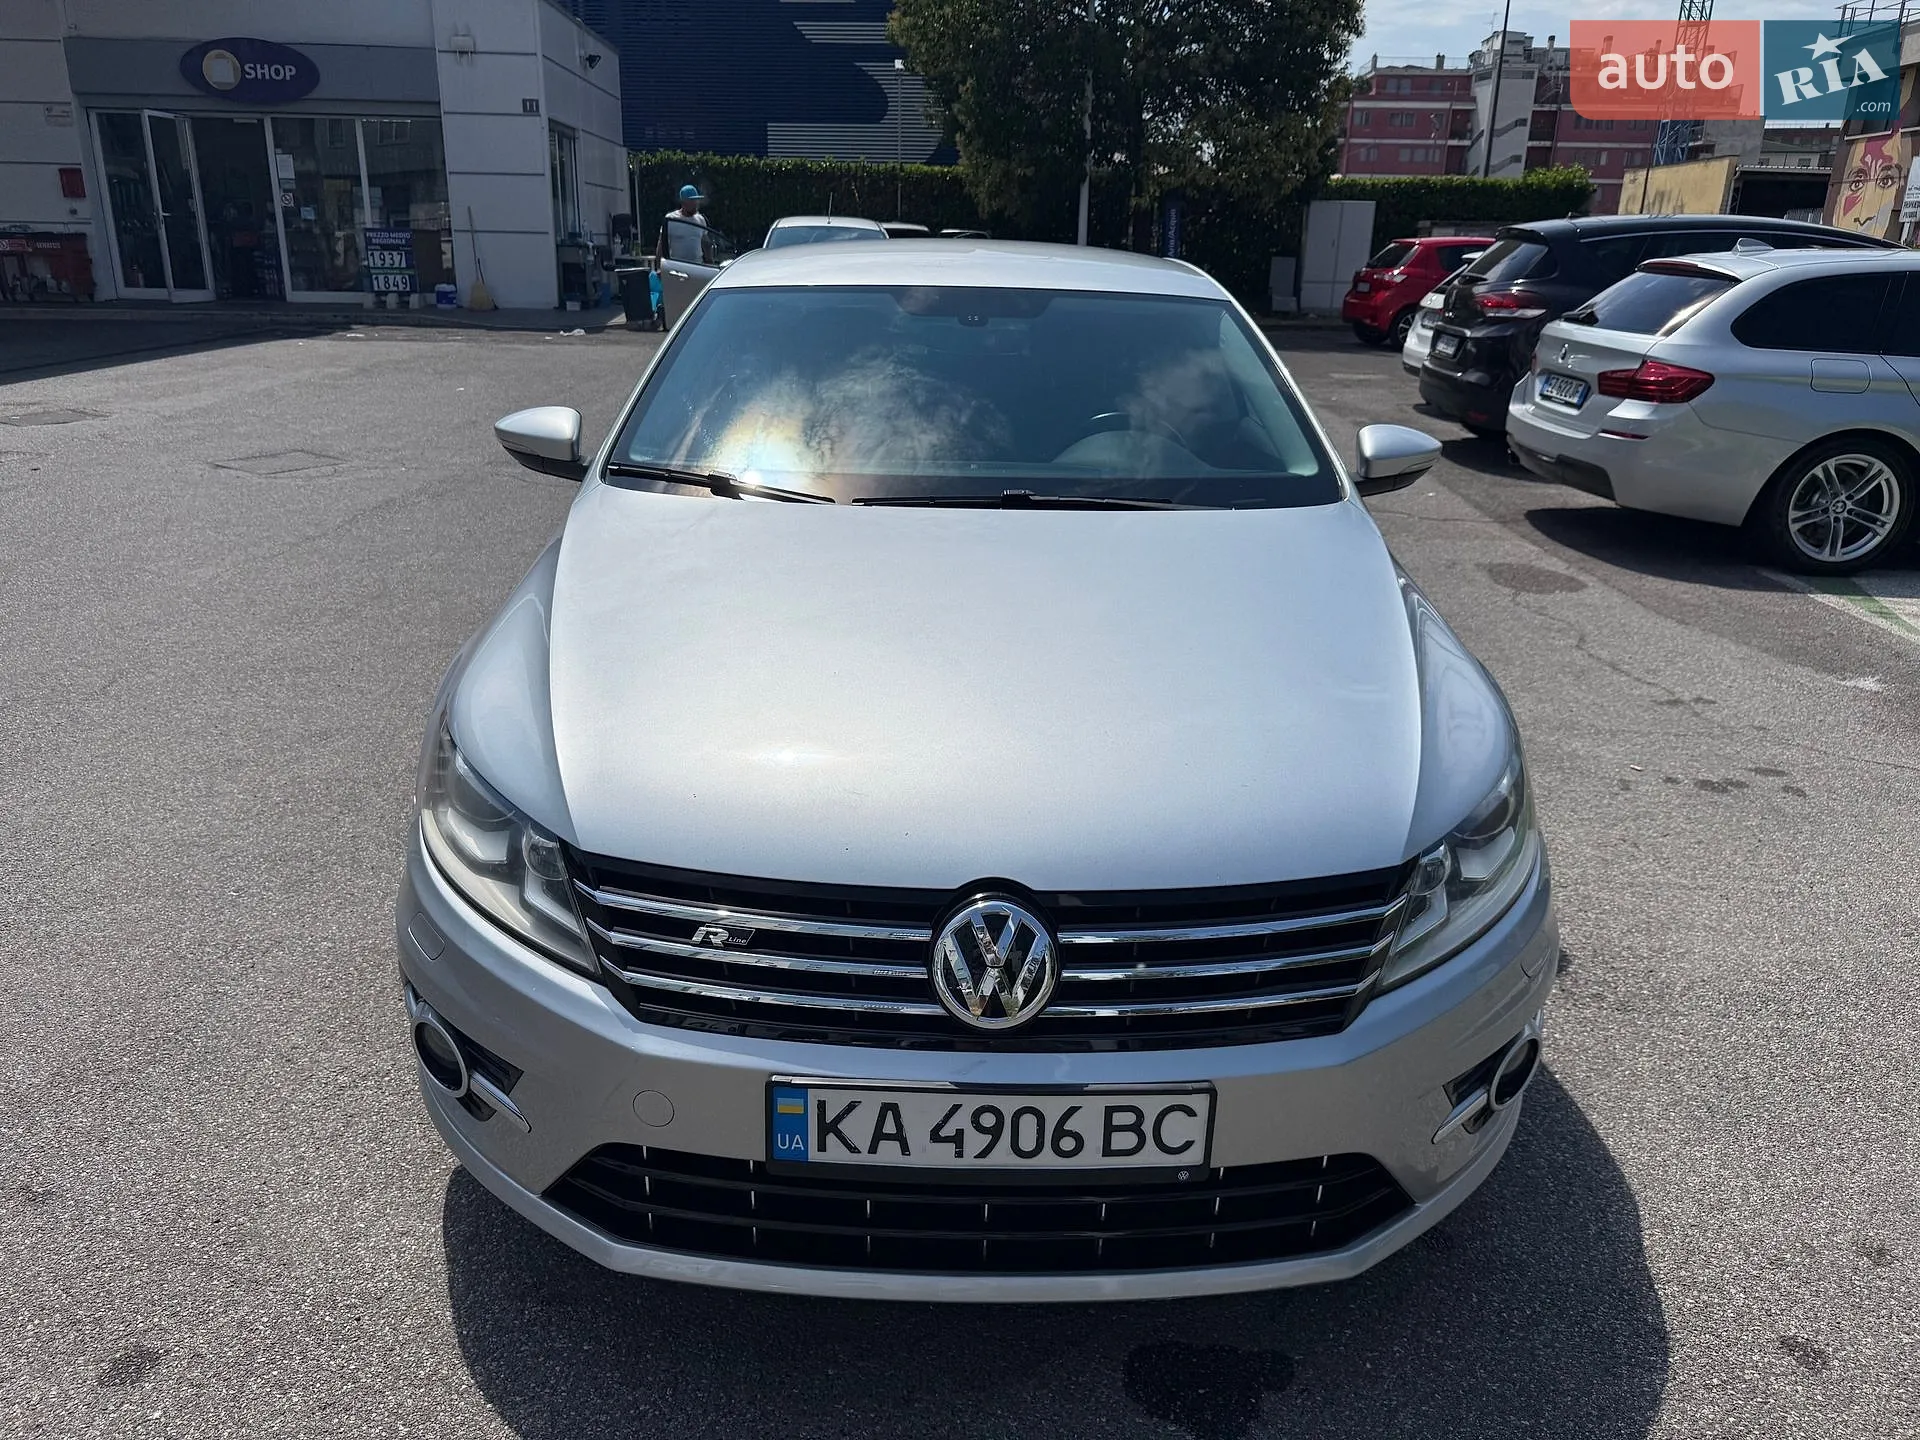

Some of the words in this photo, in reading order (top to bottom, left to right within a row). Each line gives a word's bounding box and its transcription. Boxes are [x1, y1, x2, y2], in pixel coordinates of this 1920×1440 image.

[243, 62, 297, 80] SHOP
[369, 252, 404, 266] 1937
[374, 276, 408, 290] 1849
[690, 926, 729, 947] R
[816, 1100, 911, 1157] KA
[929, 1104, 1085, 1160] 4906
[1101, 1104, 1198, 1158] BC
[777, 1133, 805, 1151] UA
